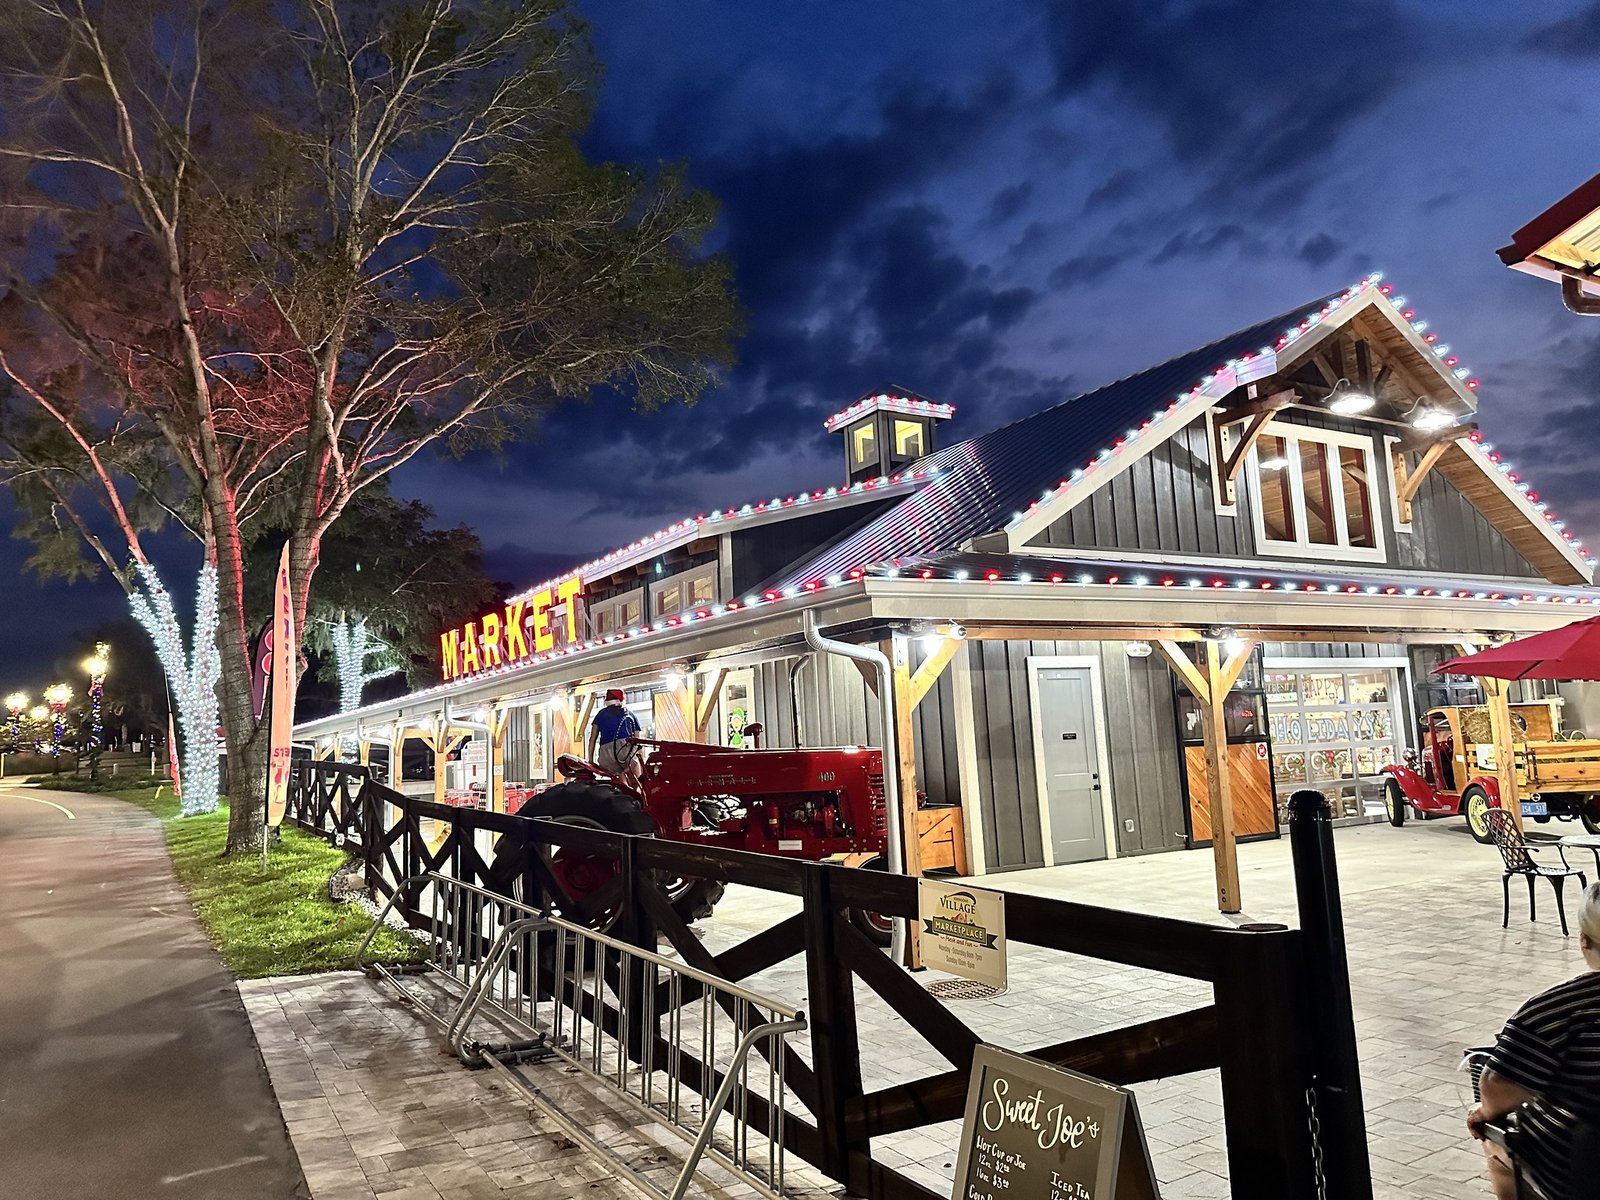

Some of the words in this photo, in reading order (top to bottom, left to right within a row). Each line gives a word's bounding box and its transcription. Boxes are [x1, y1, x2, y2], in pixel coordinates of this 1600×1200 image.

[440, 577, 584, 680] MARKET
[1274, 712, 1374, 741] HOLIDAYS
[940, 896, 976, 914] VILLAGE
[935, 921, 984, 940] MARKETPLACE
[982, 1078, 1045, 1132] Sweet
[1037, 1103, 1100, 1149] Joe's
[1050, 1170, 1073, 1192] ICED
[1075, 1182, 1090, 1200] TEA
